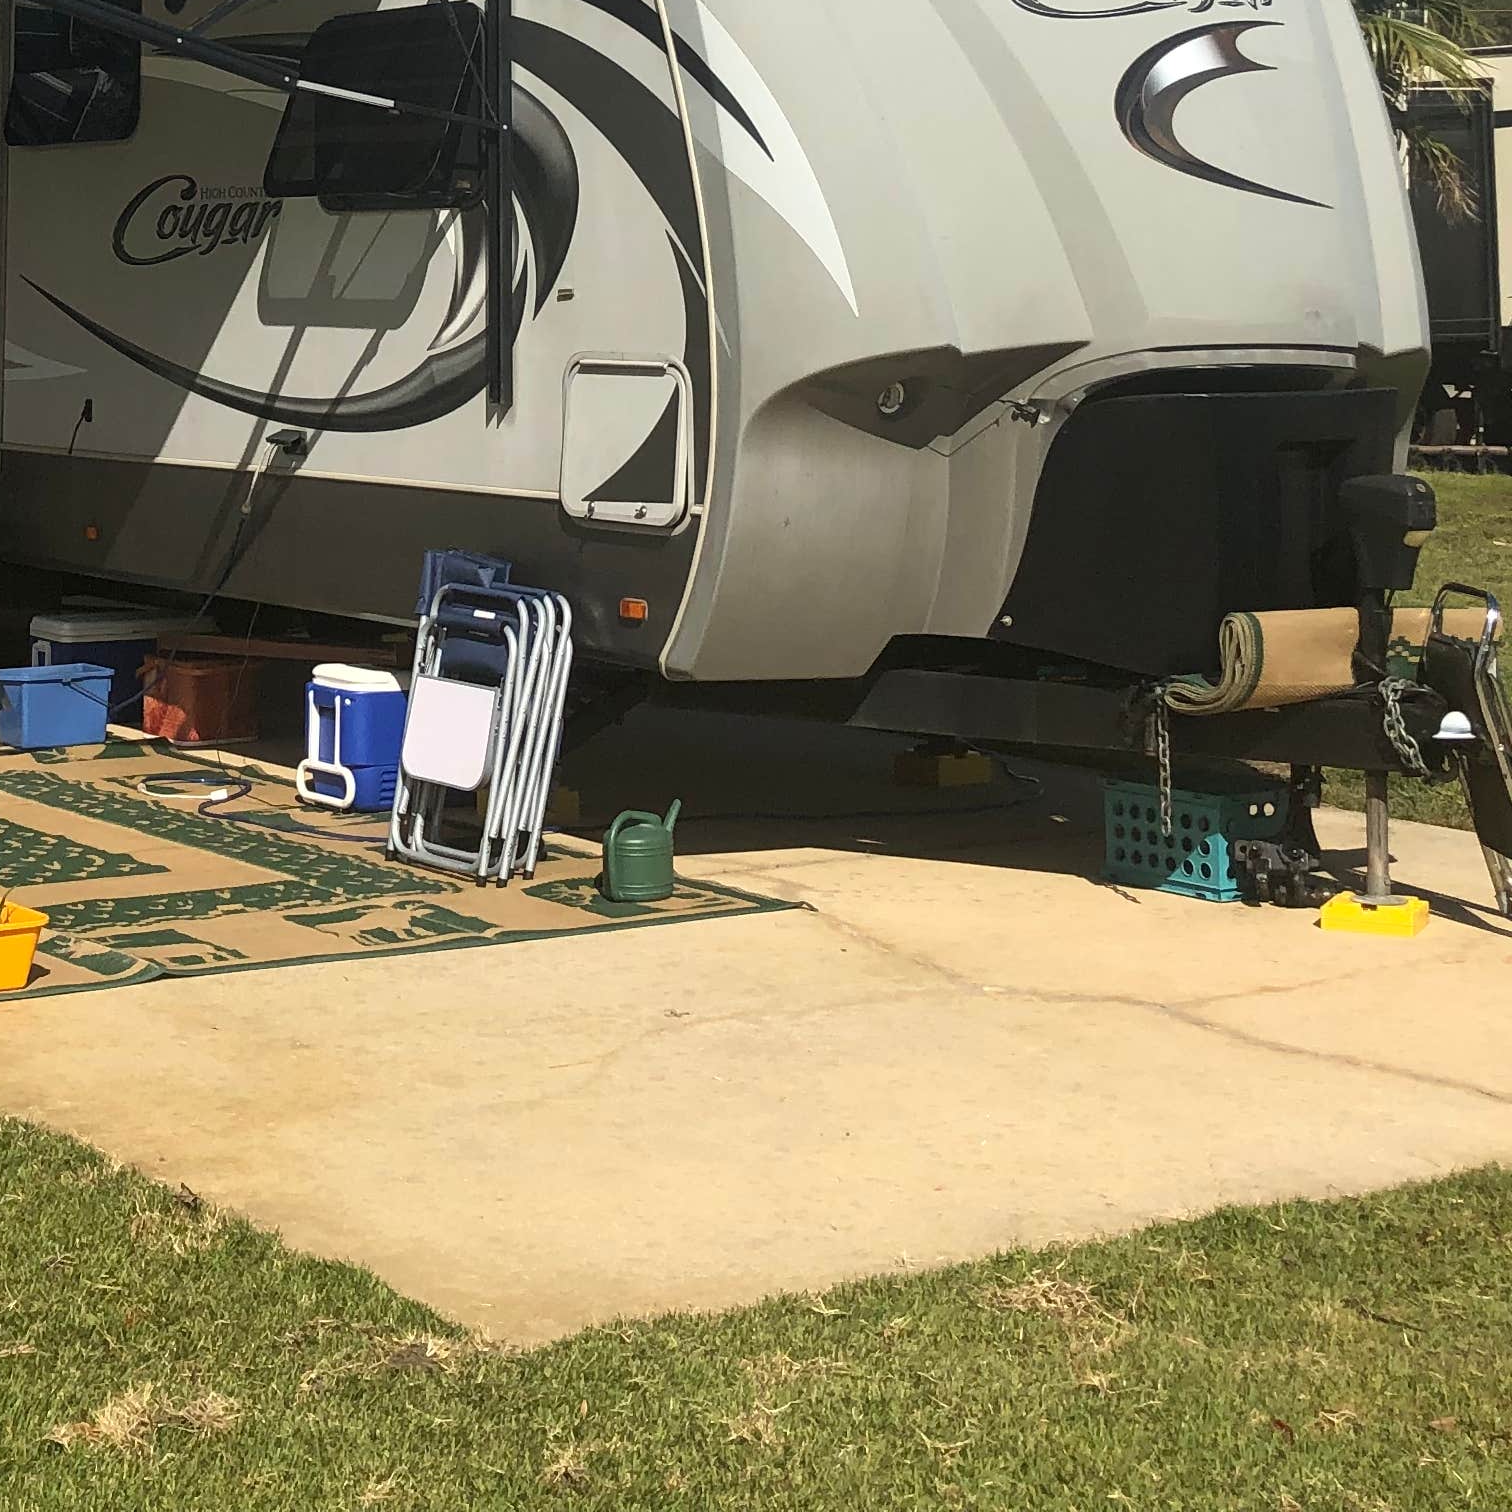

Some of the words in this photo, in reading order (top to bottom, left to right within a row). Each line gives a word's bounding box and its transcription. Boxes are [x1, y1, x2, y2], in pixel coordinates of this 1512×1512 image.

[200, 186, 227, 200] HIGH
[228, 185, 265, 199] COUNT
[112, 174, 283, 265] Cougar
